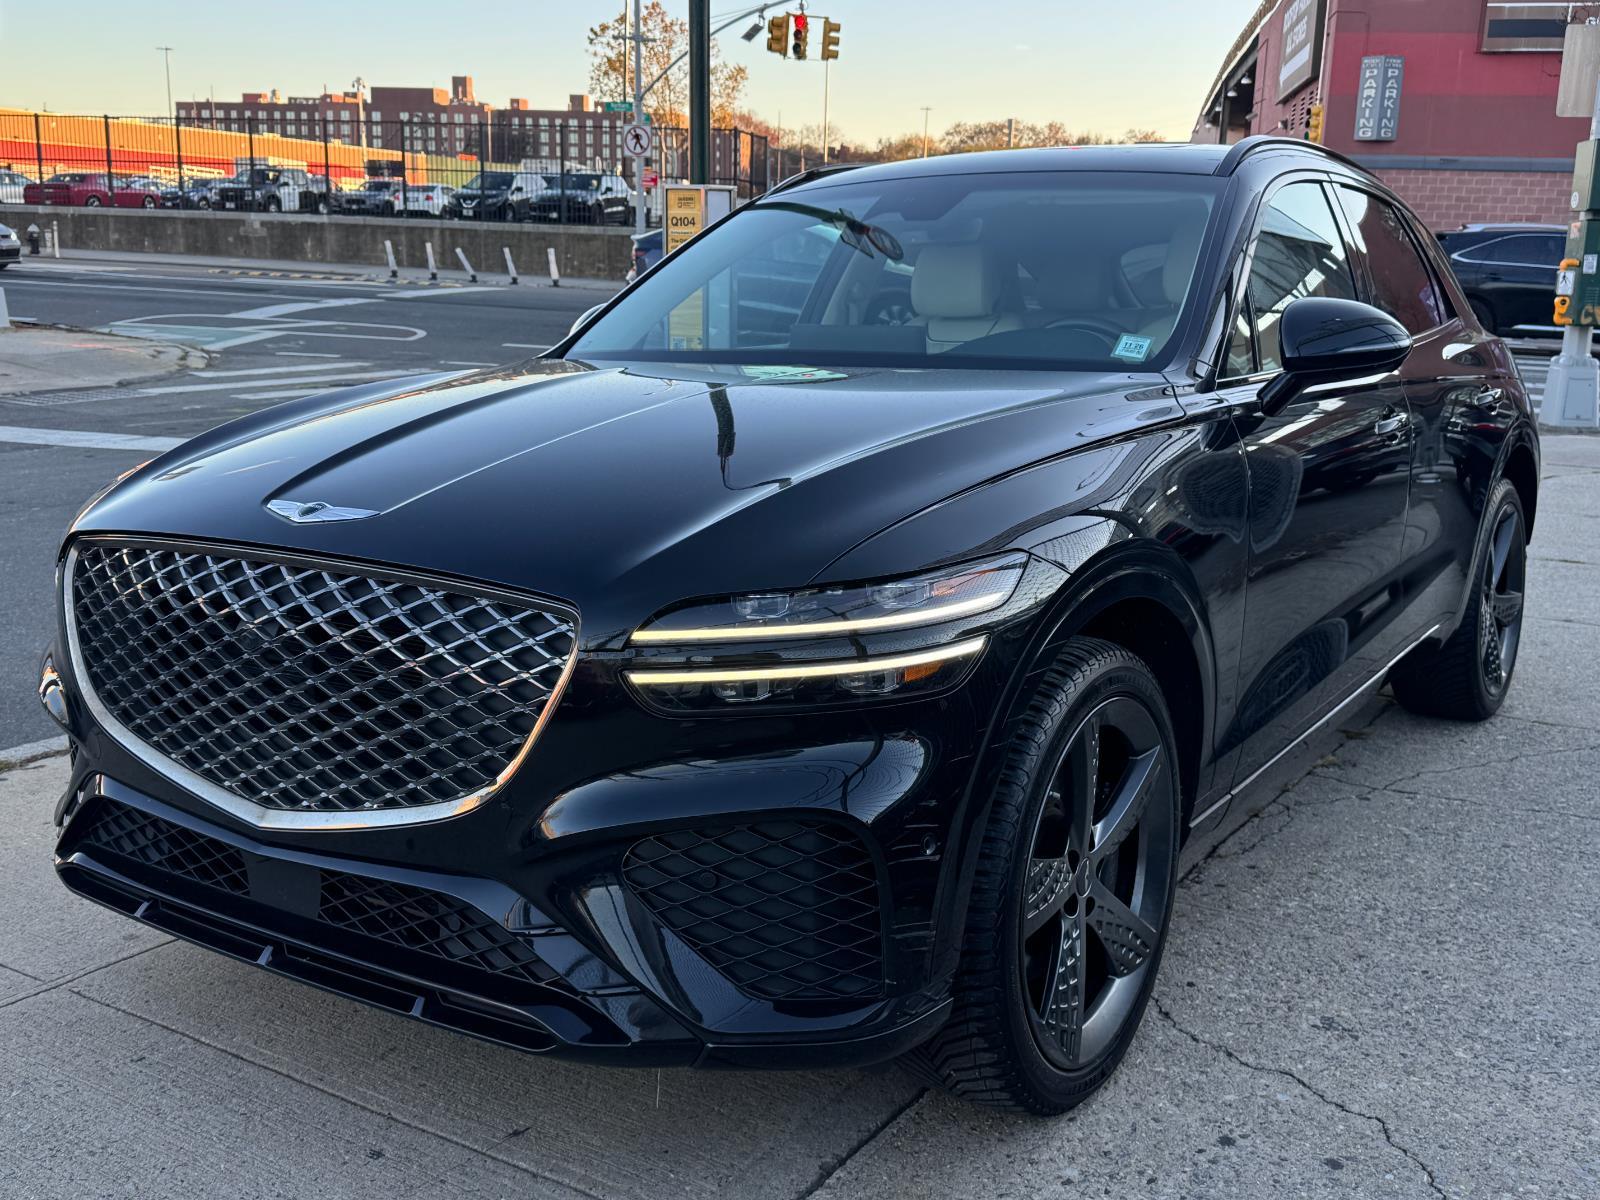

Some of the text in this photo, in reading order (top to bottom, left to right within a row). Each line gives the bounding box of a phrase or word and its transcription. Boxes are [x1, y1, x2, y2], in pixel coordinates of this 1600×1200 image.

[1358, 68, 1378, 137] PARKING
[1381, 68, 1399, 137] PARKING
[671, 216, 696, 227] Q104
